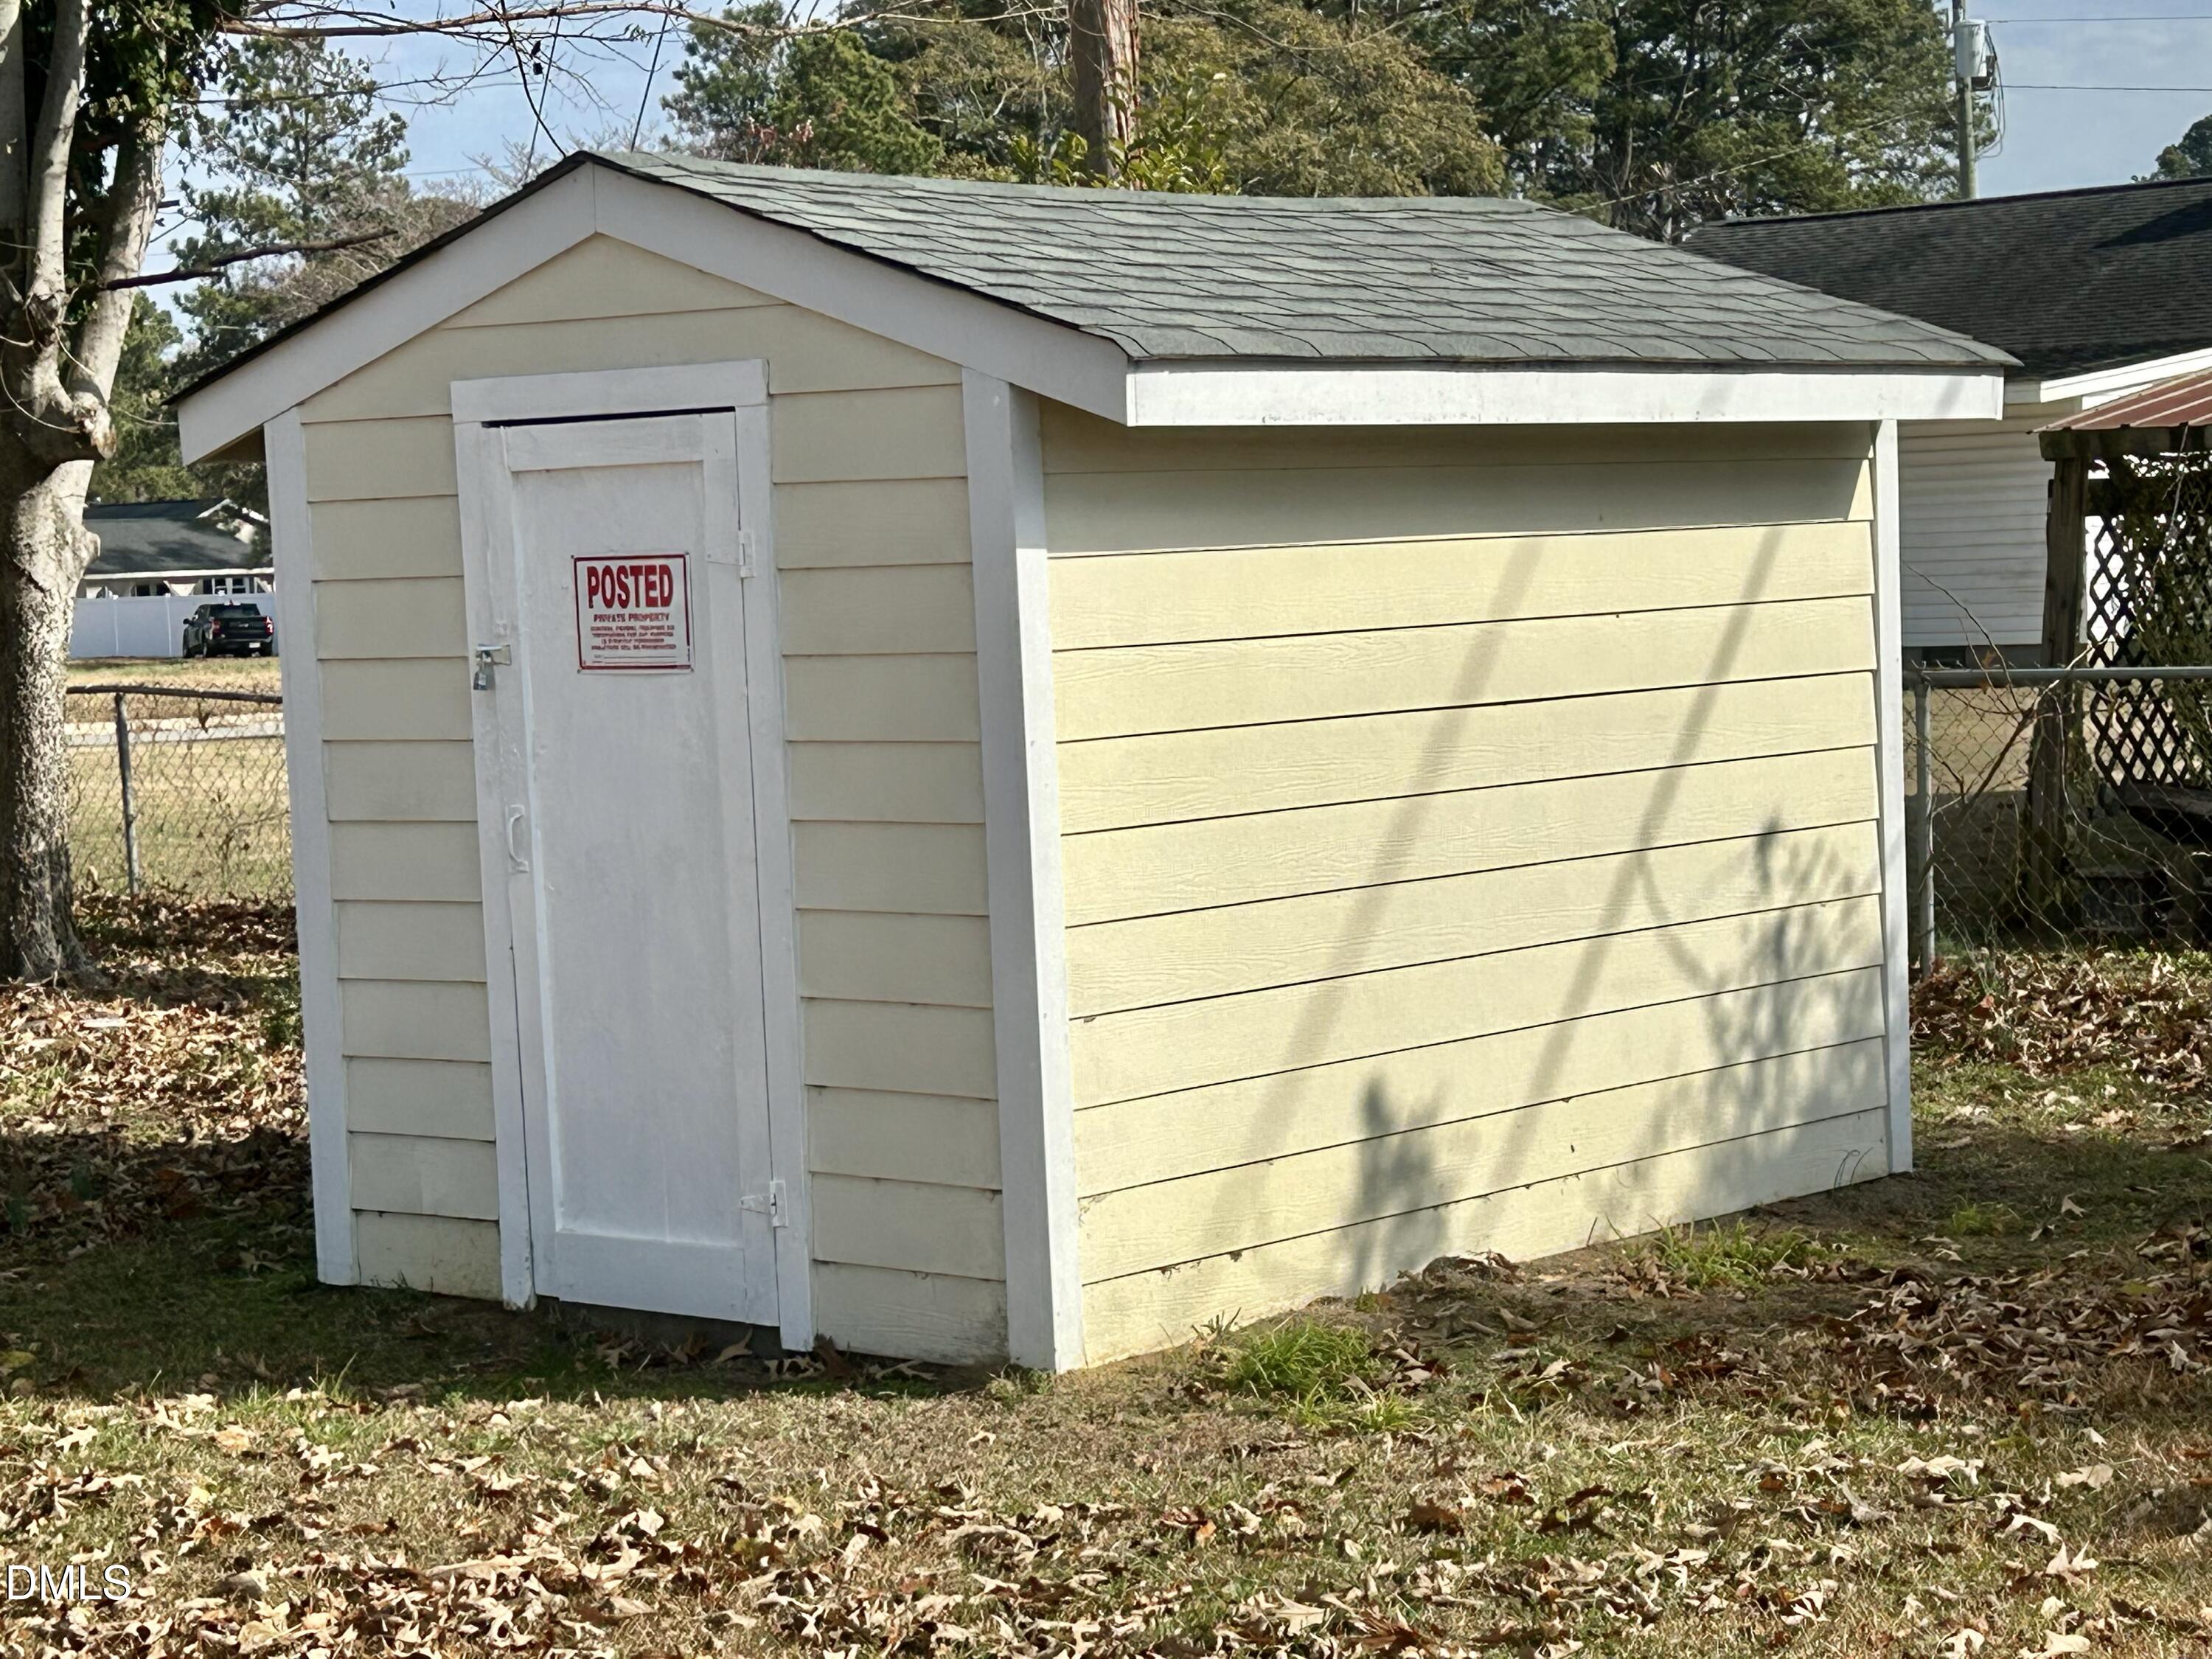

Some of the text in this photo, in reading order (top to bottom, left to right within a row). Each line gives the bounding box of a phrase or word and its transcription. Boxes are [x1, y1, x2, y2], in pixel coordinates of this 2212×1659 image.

[587, 564, 673, 609] POSTED
[594, 613, 669, 622] PRIVATE PROPERTY
